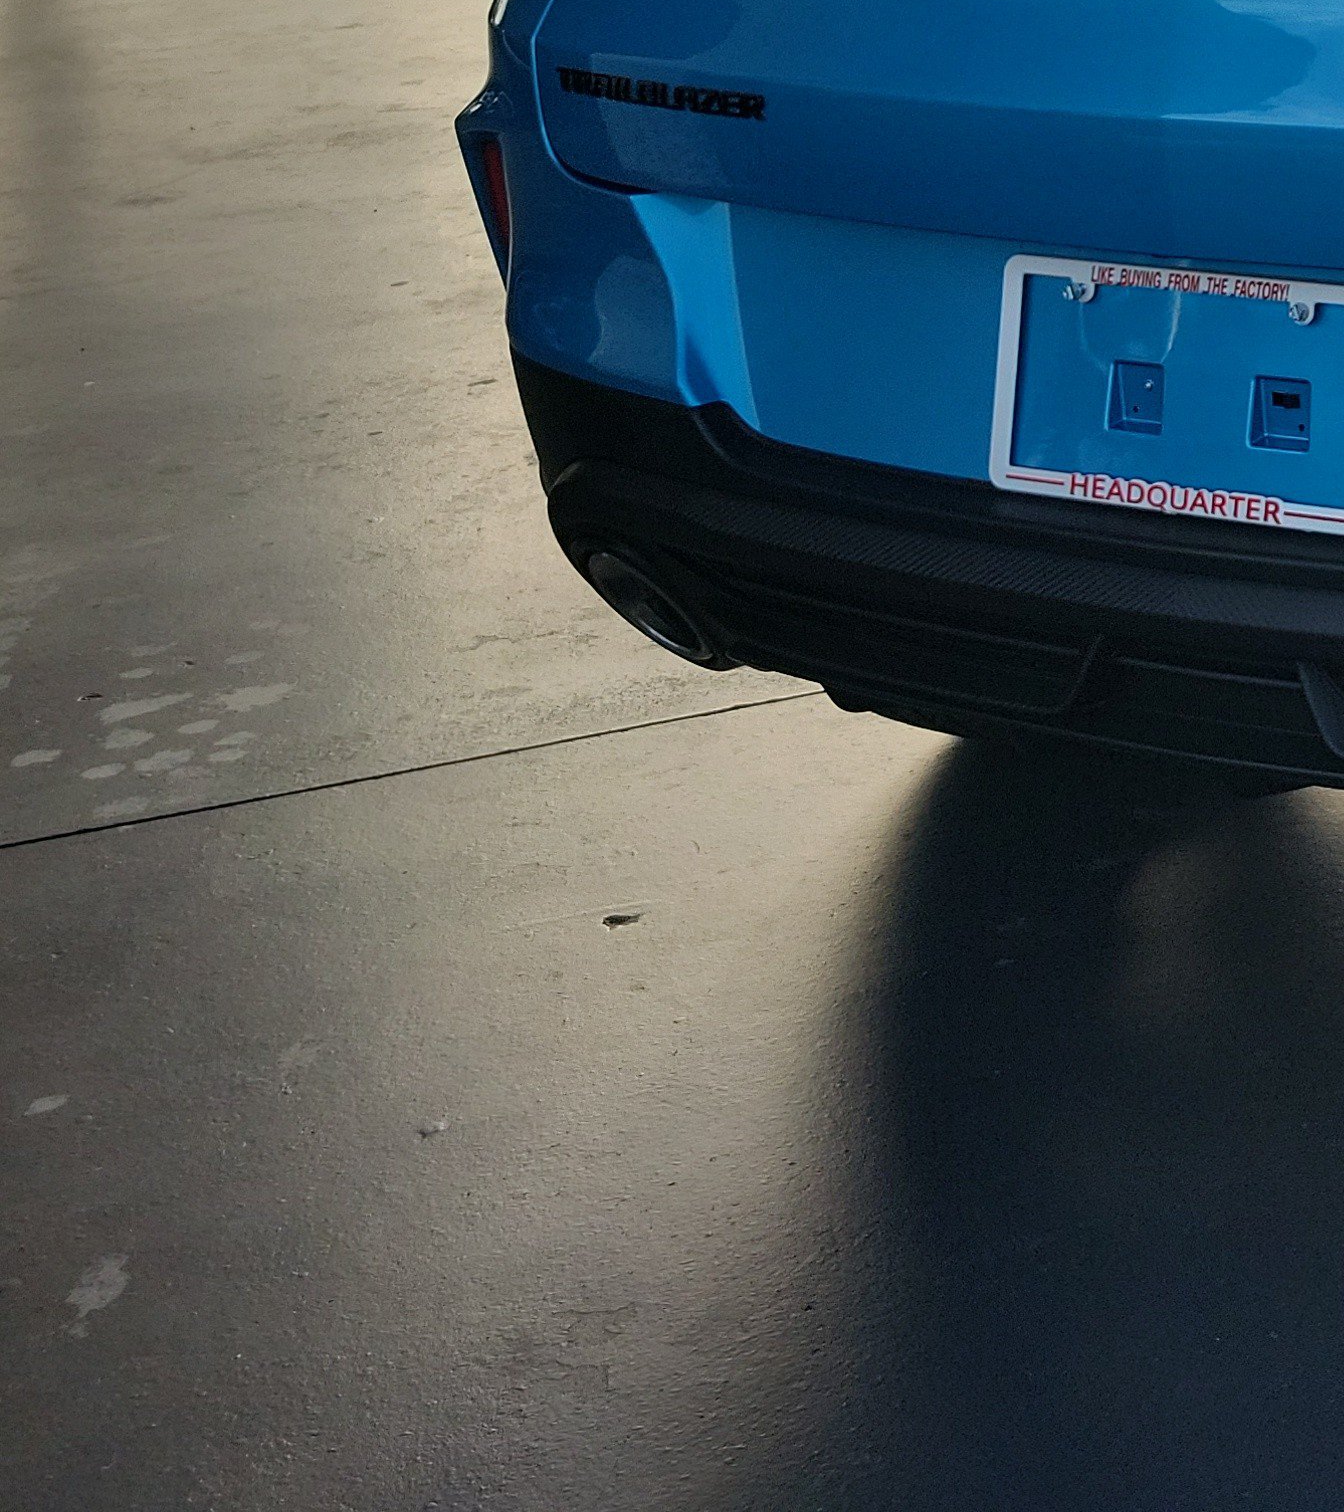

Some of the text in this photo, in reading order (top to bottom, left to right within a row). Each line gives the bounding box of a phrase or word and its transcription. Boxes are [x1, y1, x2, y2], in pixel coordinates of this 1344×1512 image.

[1091, 264, 1290, 301] LIKE BUYING FROM THE FACTORY!
[1070, 473, 1282, 525] HEADQUARTER
